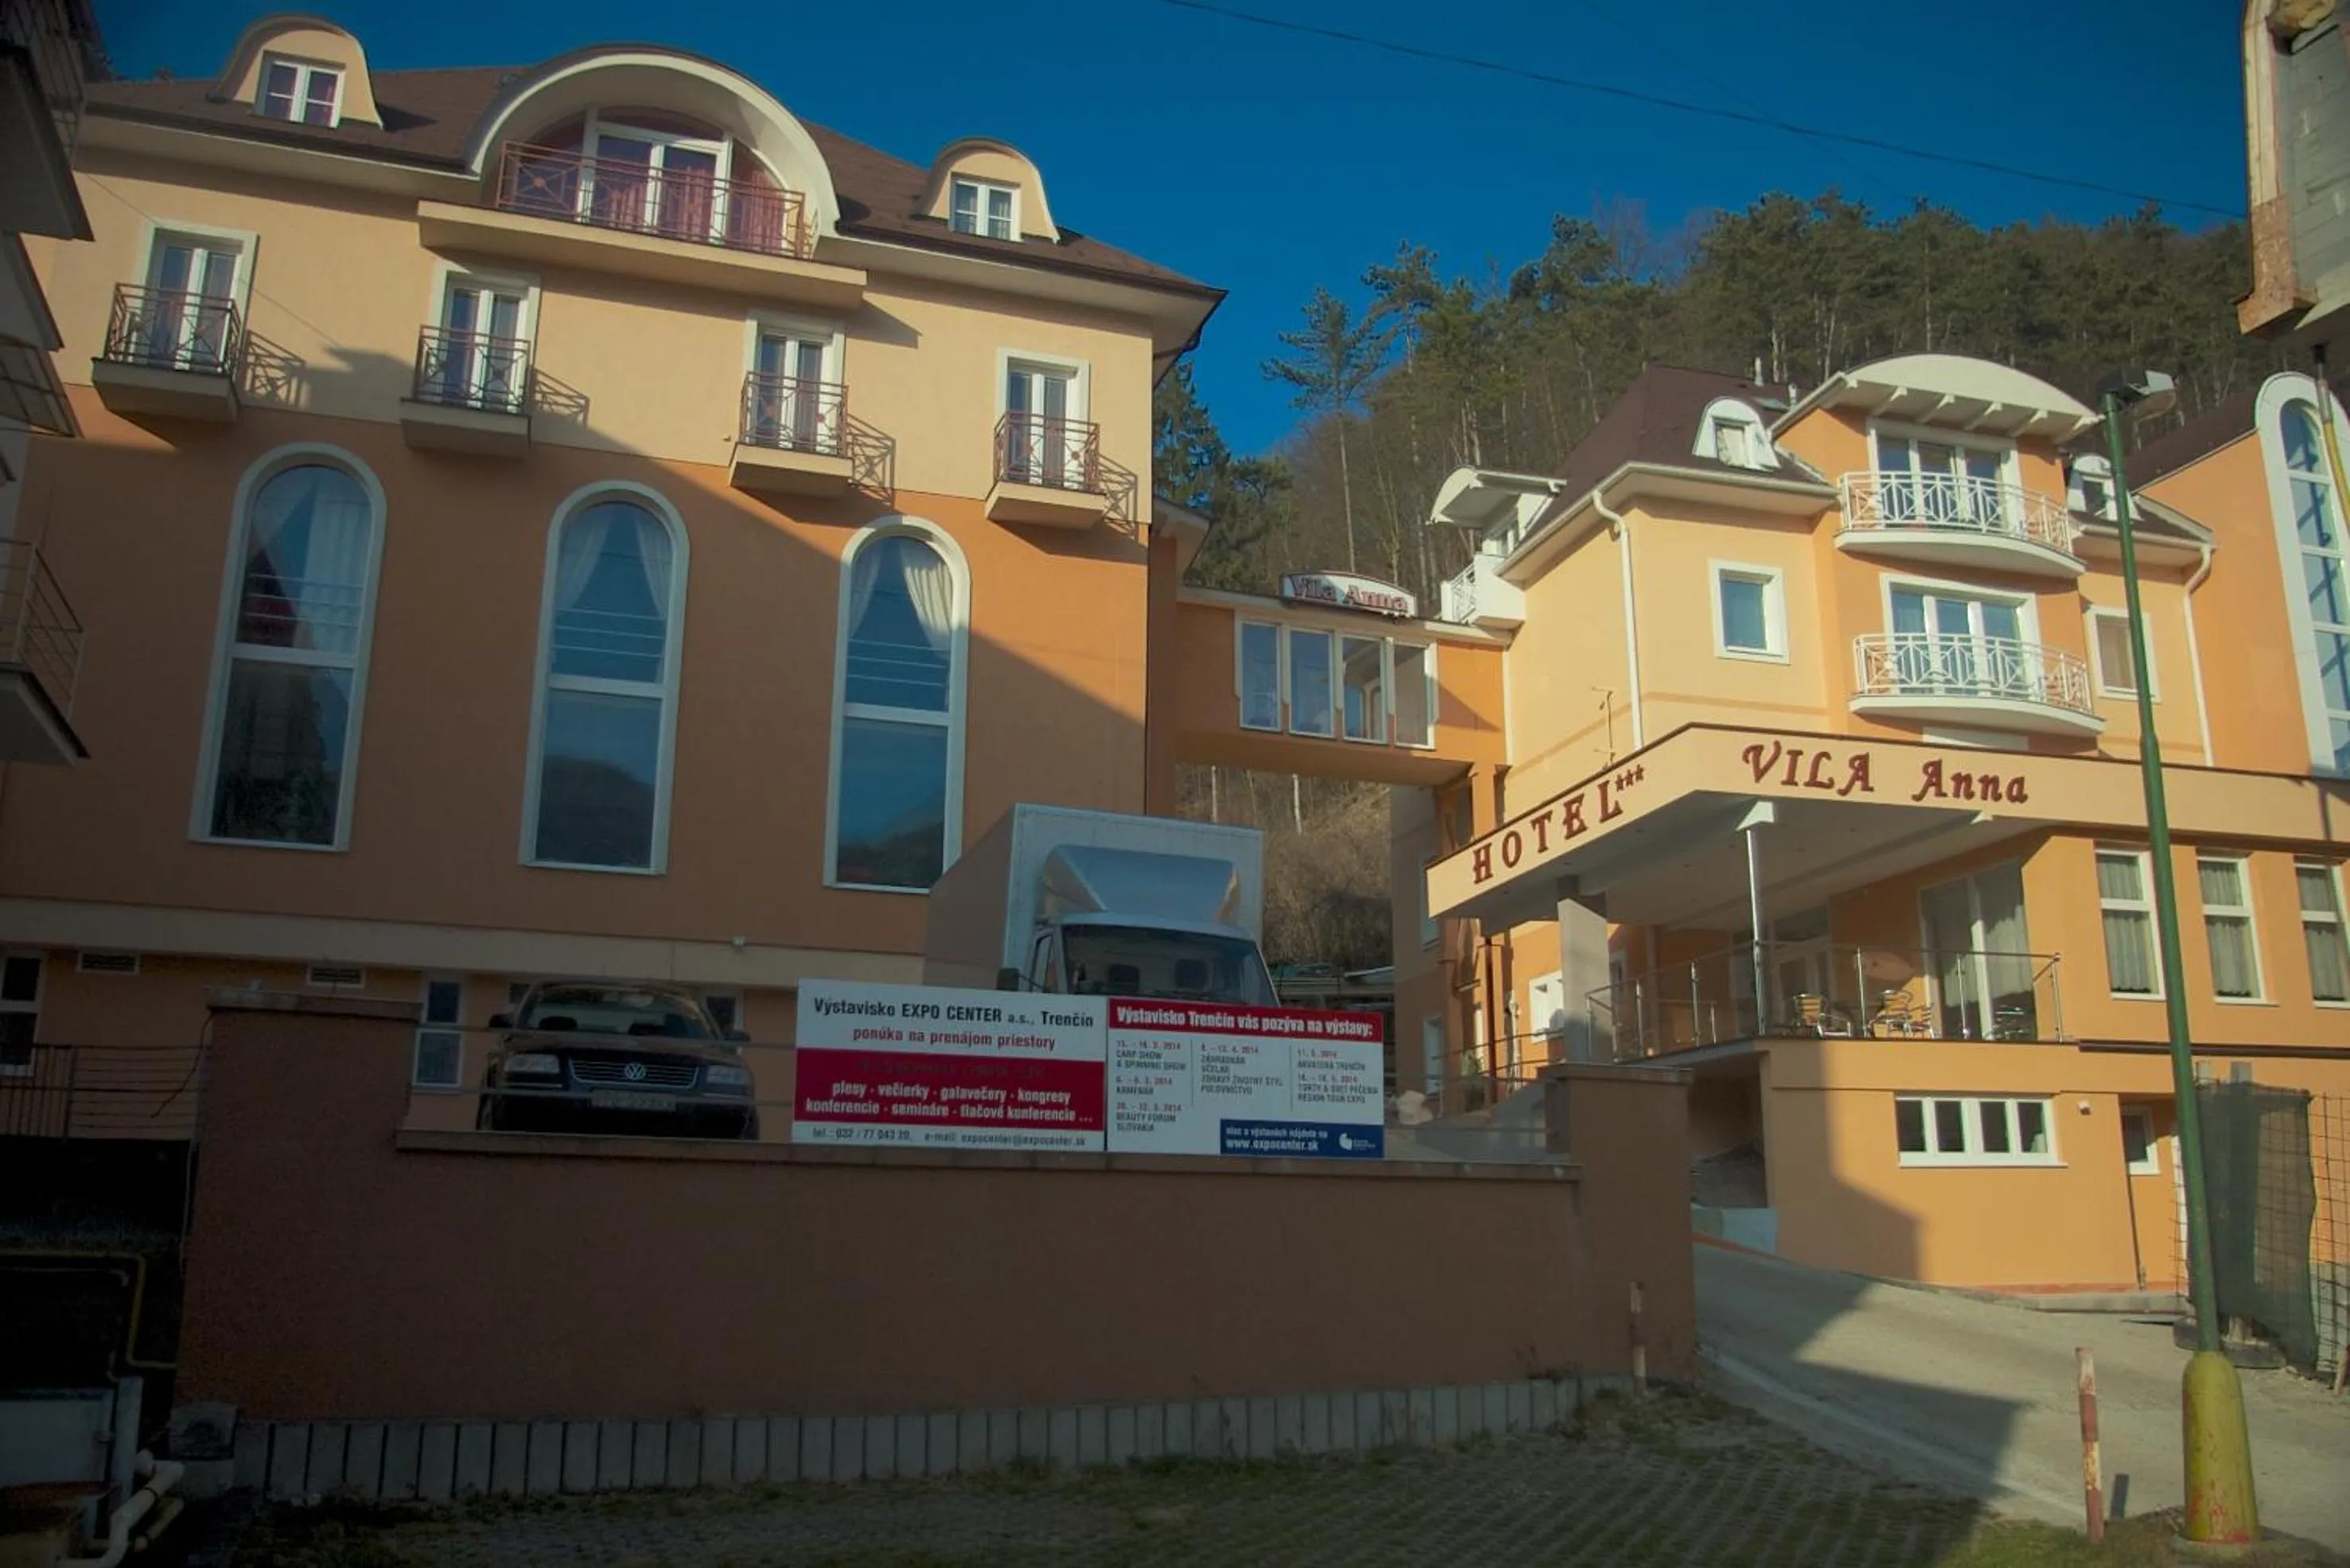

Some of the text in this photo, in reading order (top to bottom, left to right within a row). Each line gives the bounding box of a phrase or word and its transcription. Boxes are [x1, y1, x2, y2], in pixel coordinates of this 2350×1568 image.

[1344, 584, 1409, 613] Anna
[1742, 741, 2029, 803] VILA Anna
[1473, 780, 1624, 885] HOTEL
[814, 997, 895, 1017] Výstavisko
[901, 1002, 940, 1020] EXPO
[947, 1006, 1002, 1023] CENTER
[1041, 1010, 1094, 1028] Trenčín
[1116, 1006, 1373, 1036] Výstavisko Trenčín vás pozýva na výstavy:
[853, 1026, 1056, 1051] ponúka na prenájom priestory
[804, 1098, 880, 1115] konferencie
[1006, 1105, 1076, 1122] konferencie
[1017, 1088, 1071, 1106] kongresy
[1225, 1138, 1319, 1151] www.expocenter.sk
